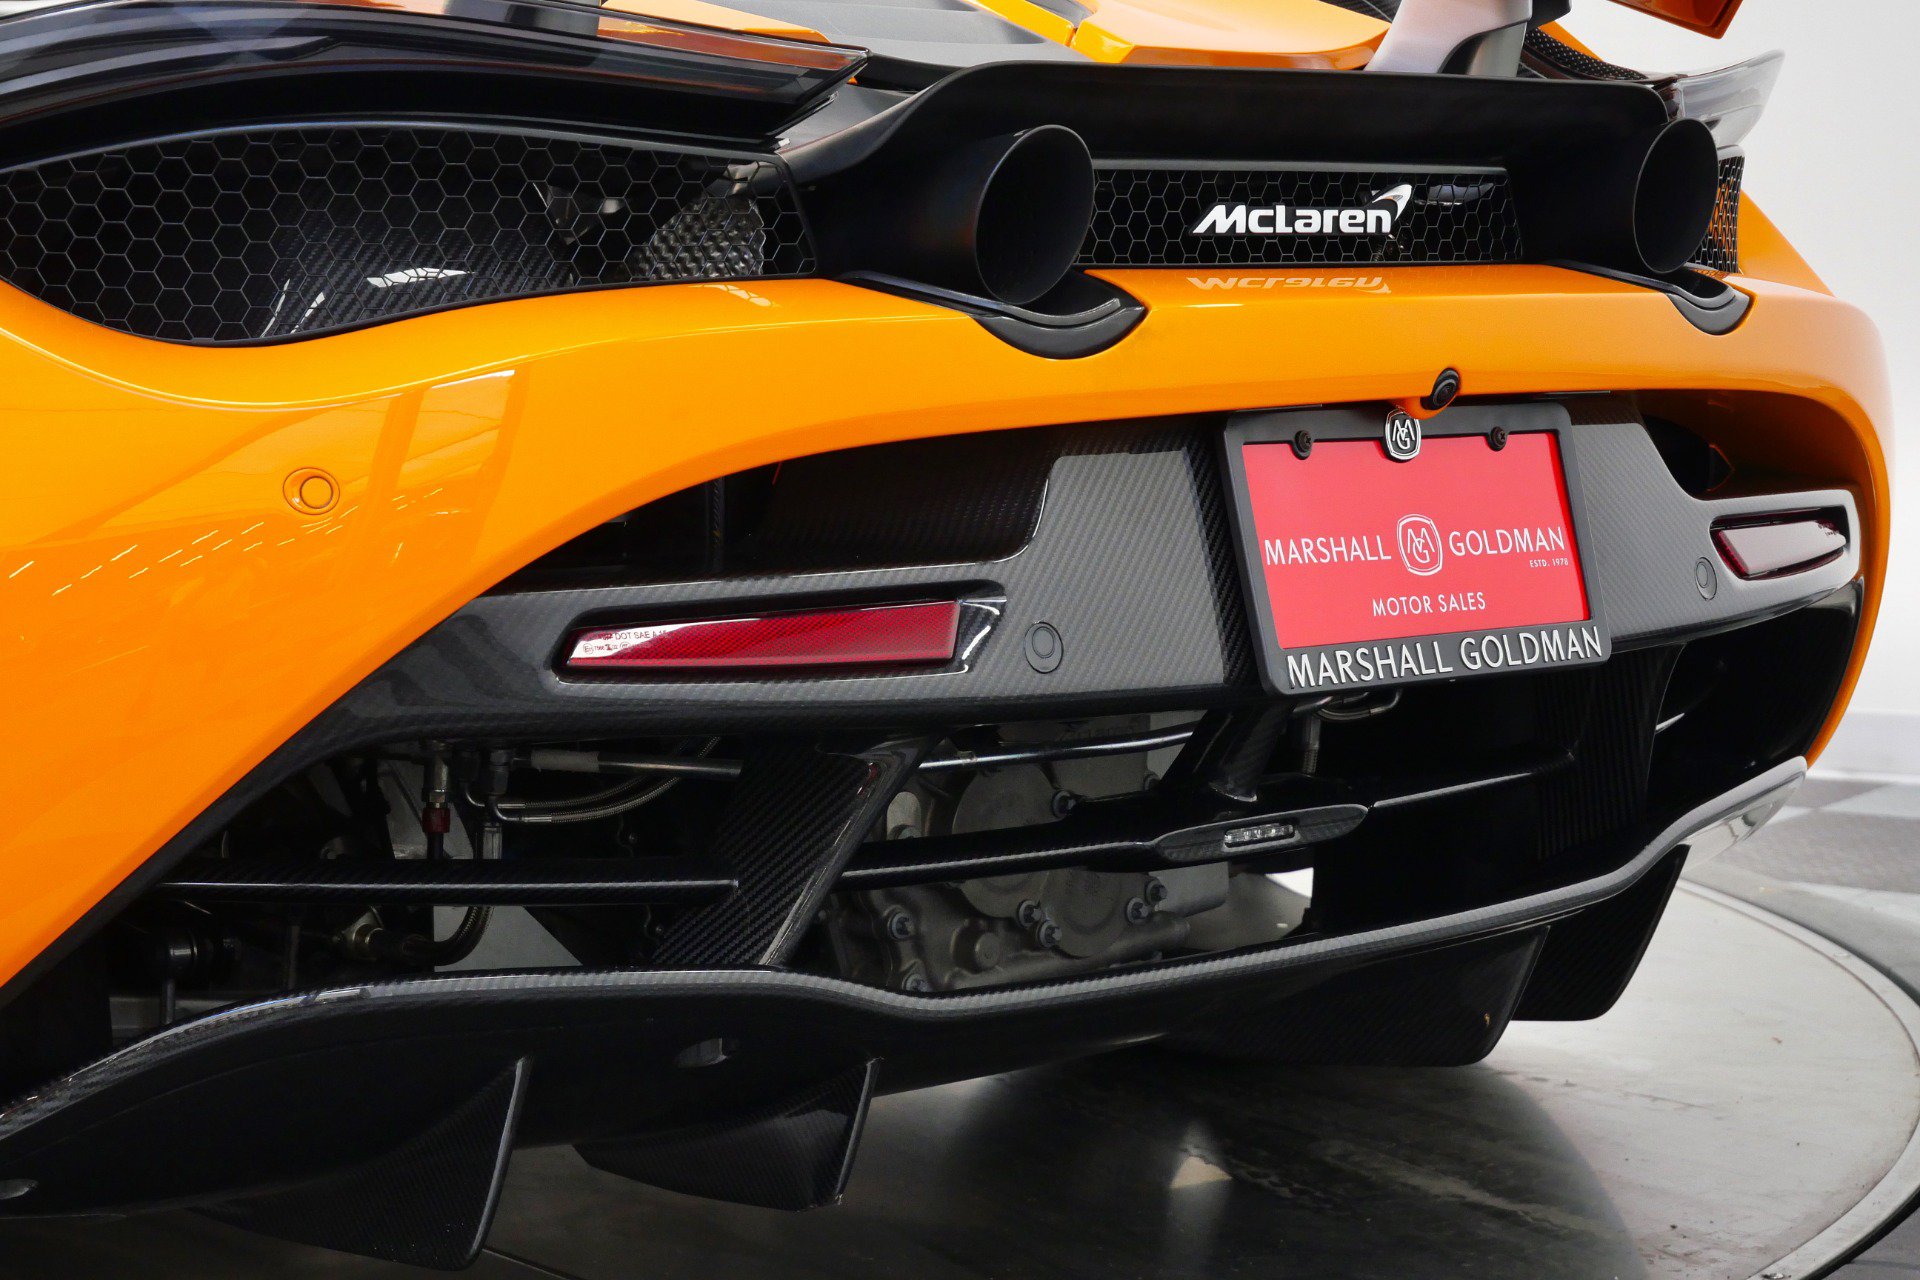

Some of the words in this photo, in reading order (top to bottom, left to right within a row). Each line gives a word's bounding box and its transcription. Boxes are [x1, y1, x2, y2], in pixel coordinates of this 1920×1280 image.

[1192, 204, 1391, 233] McLaren
[1264, 535, 1392, 565] MARSHALL
[1449, 526, 1566, 557] GOLDMAN
[1529, 559, 1550, 568] ESTD.
[1552, 557, 1569, 566] 1978
[1372, 596, 1433, 617] MOTOR
[1439, 591, 1486, 611] SALES
[615, 632, 632, 640] DOT
[1287, 641, 1453, 688] MARSHALL
[1460, 625, 1603, 669] GOLDMAN
